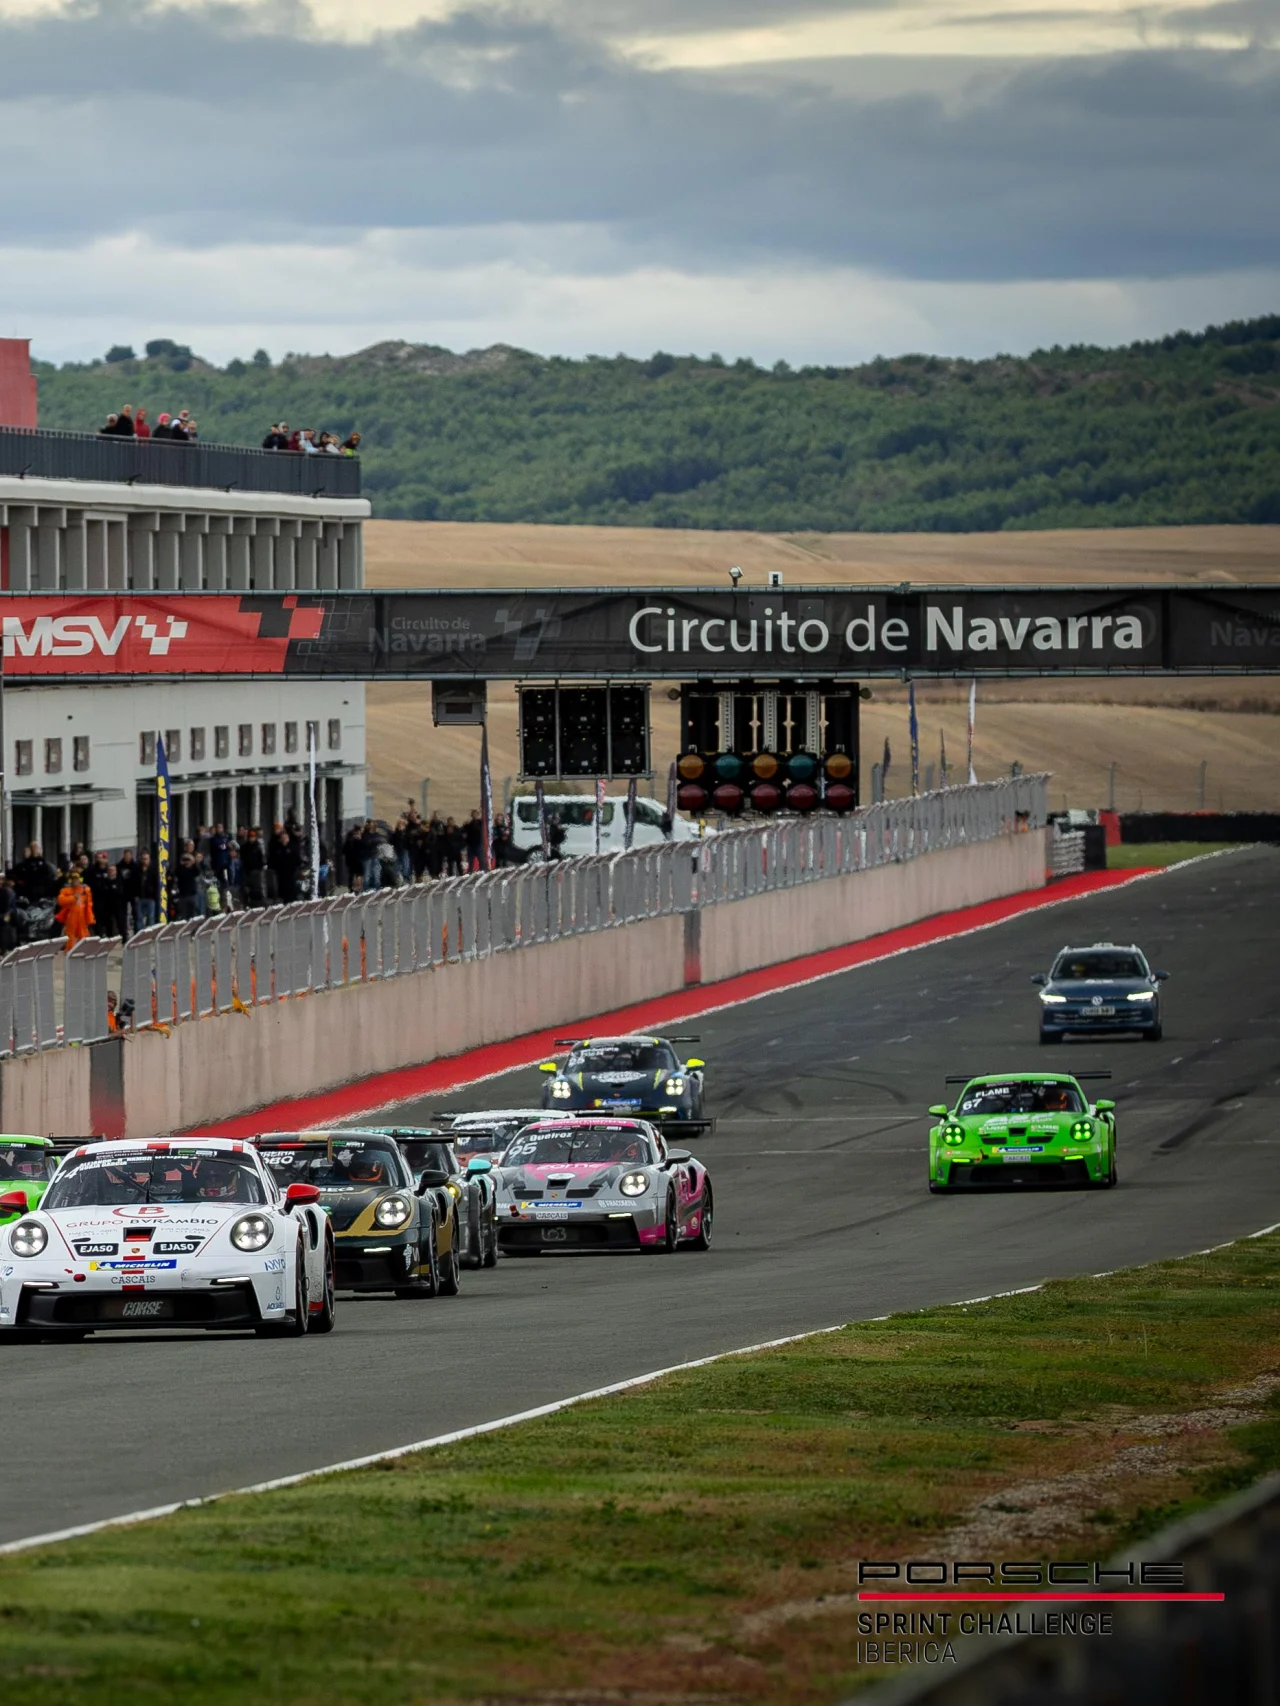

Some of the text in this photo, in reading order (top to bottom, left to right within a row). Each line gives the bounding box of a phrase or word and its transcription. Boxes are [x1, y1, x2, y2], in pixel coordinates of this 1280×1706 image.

[391, 617, 471, 630] Circuito de
[629, 605, 1143, 652] Circuito de Navarra
[2, 615, 132, 656] MSV
[369, 627, 487, 653] Navarra
[976, 1087, 1010, 1098] FLAME
[962, 1098, 982, 1111] 67
[530, 1132, 573, 1141] Queiroz
[509, 1142, 538, 1158] 95
[54, 1165, 80, 1184] 14
[66, 1219, 124, 1228] GRUPO
[79, 1245, 114, 1253] EJASO
[160, 1243, 195, 1251] EJASO
[114, 1261, 171, 1269] MICHELIN
[111, 1275, 156, 1285] CASCAIS
[122, 1301, 164, 1317] CORSE
